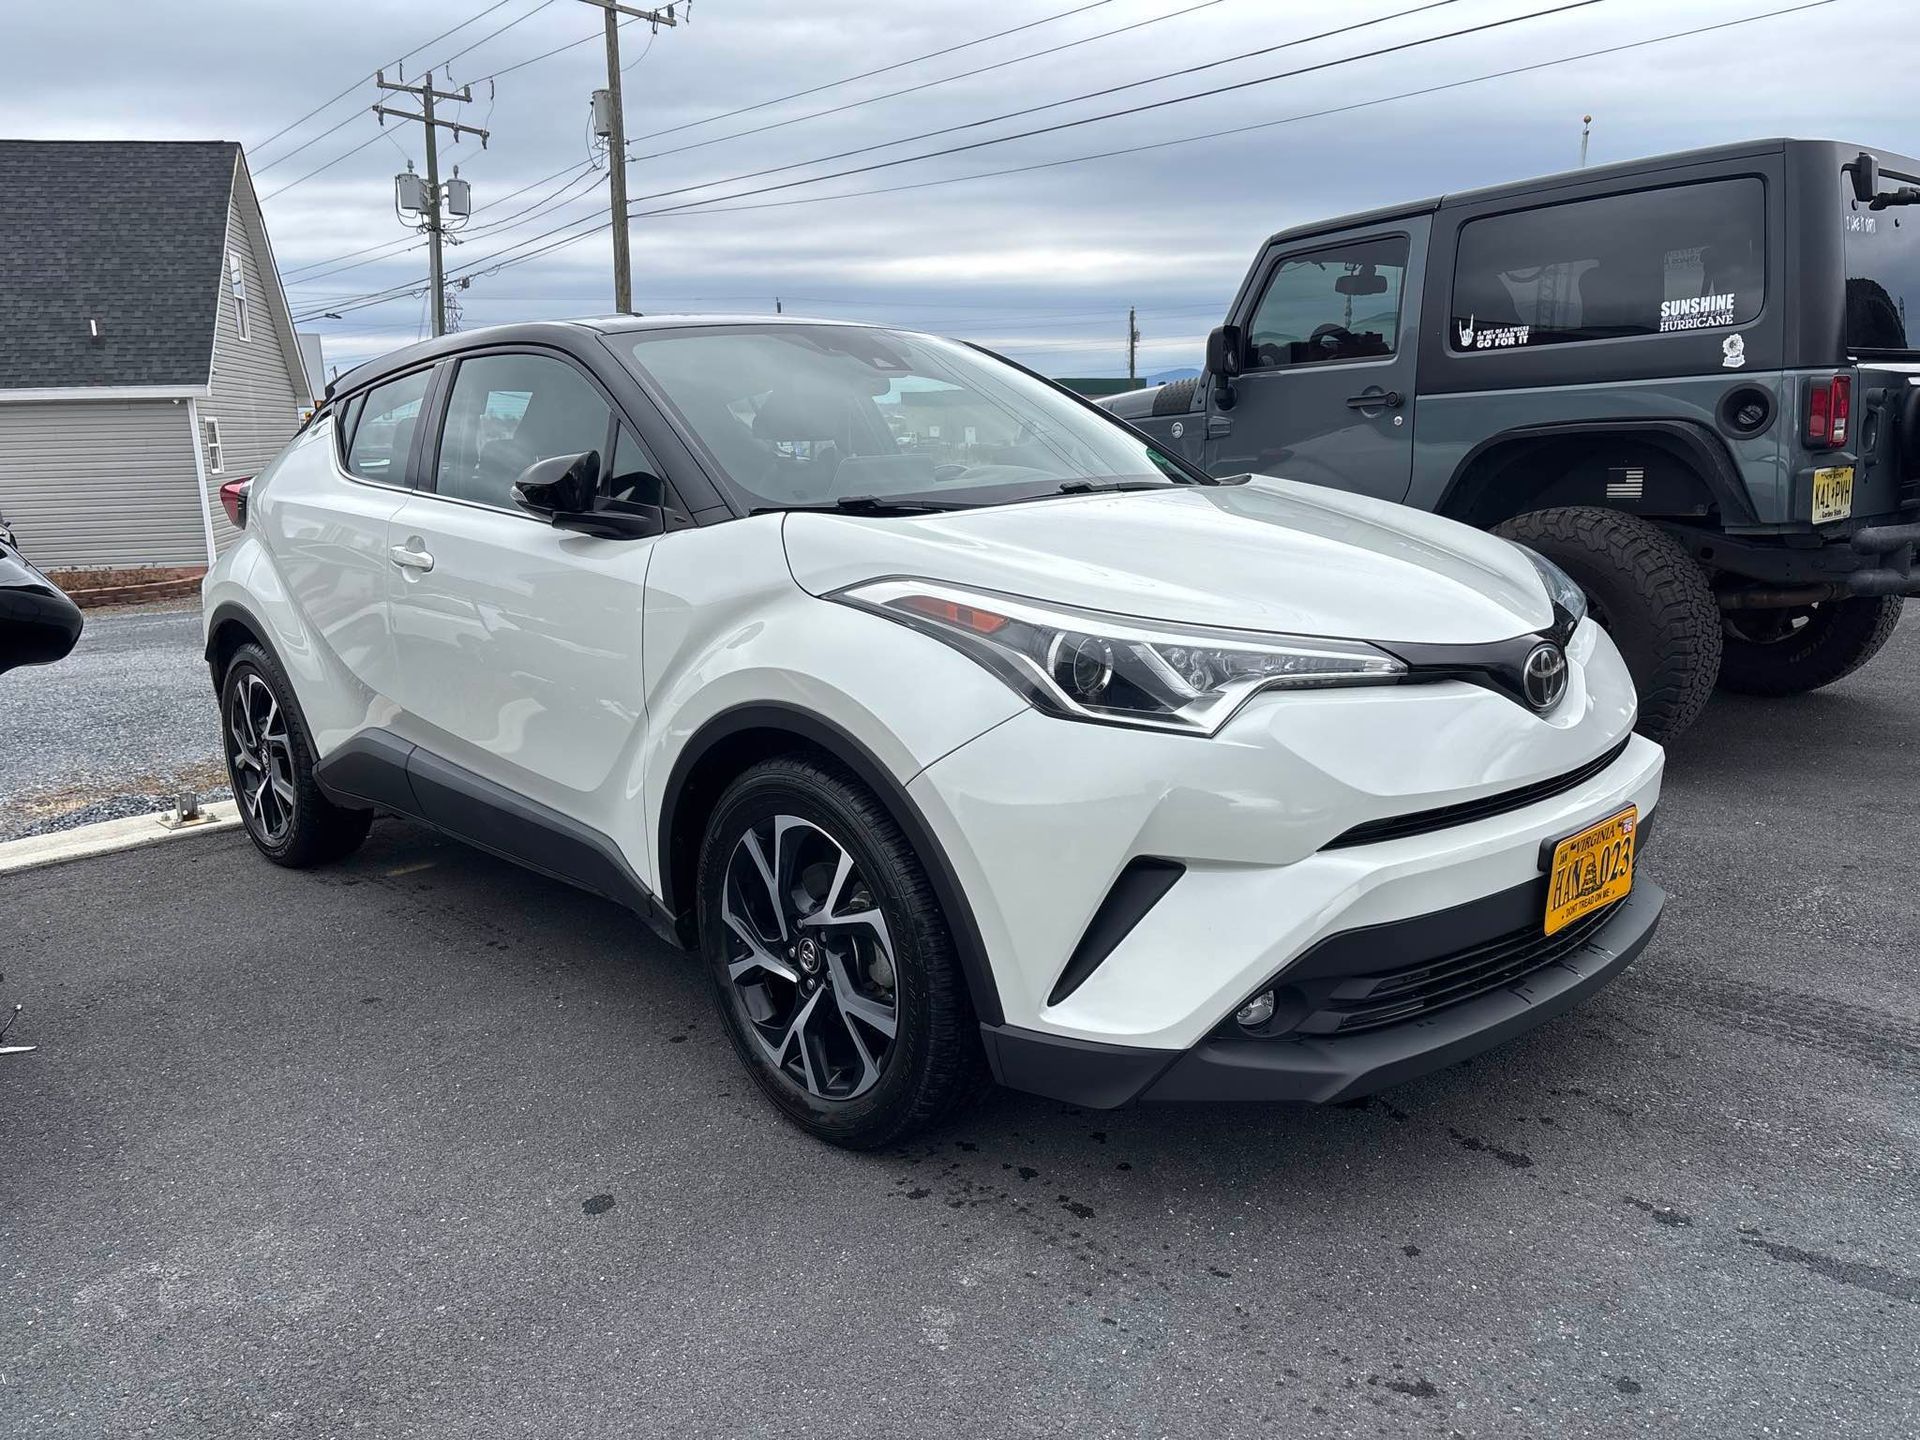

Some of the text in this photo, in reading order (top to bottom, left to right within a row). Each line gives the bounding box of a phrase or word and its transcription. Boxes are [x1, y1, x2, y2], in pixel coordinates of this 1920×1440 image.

[1661, 293, 1735, 317] SUNSHINE
[1660, 314, 1734, 332] HURRICANE
[1477, 340, 1492, 348] GO
[1495, 338, 1515, 346] FOR
[1575, 825, 1615, 853] VIRGINIA
[1600, 837, 1631, 885] 023
[1579, 896, 1595, 908] TREAD
